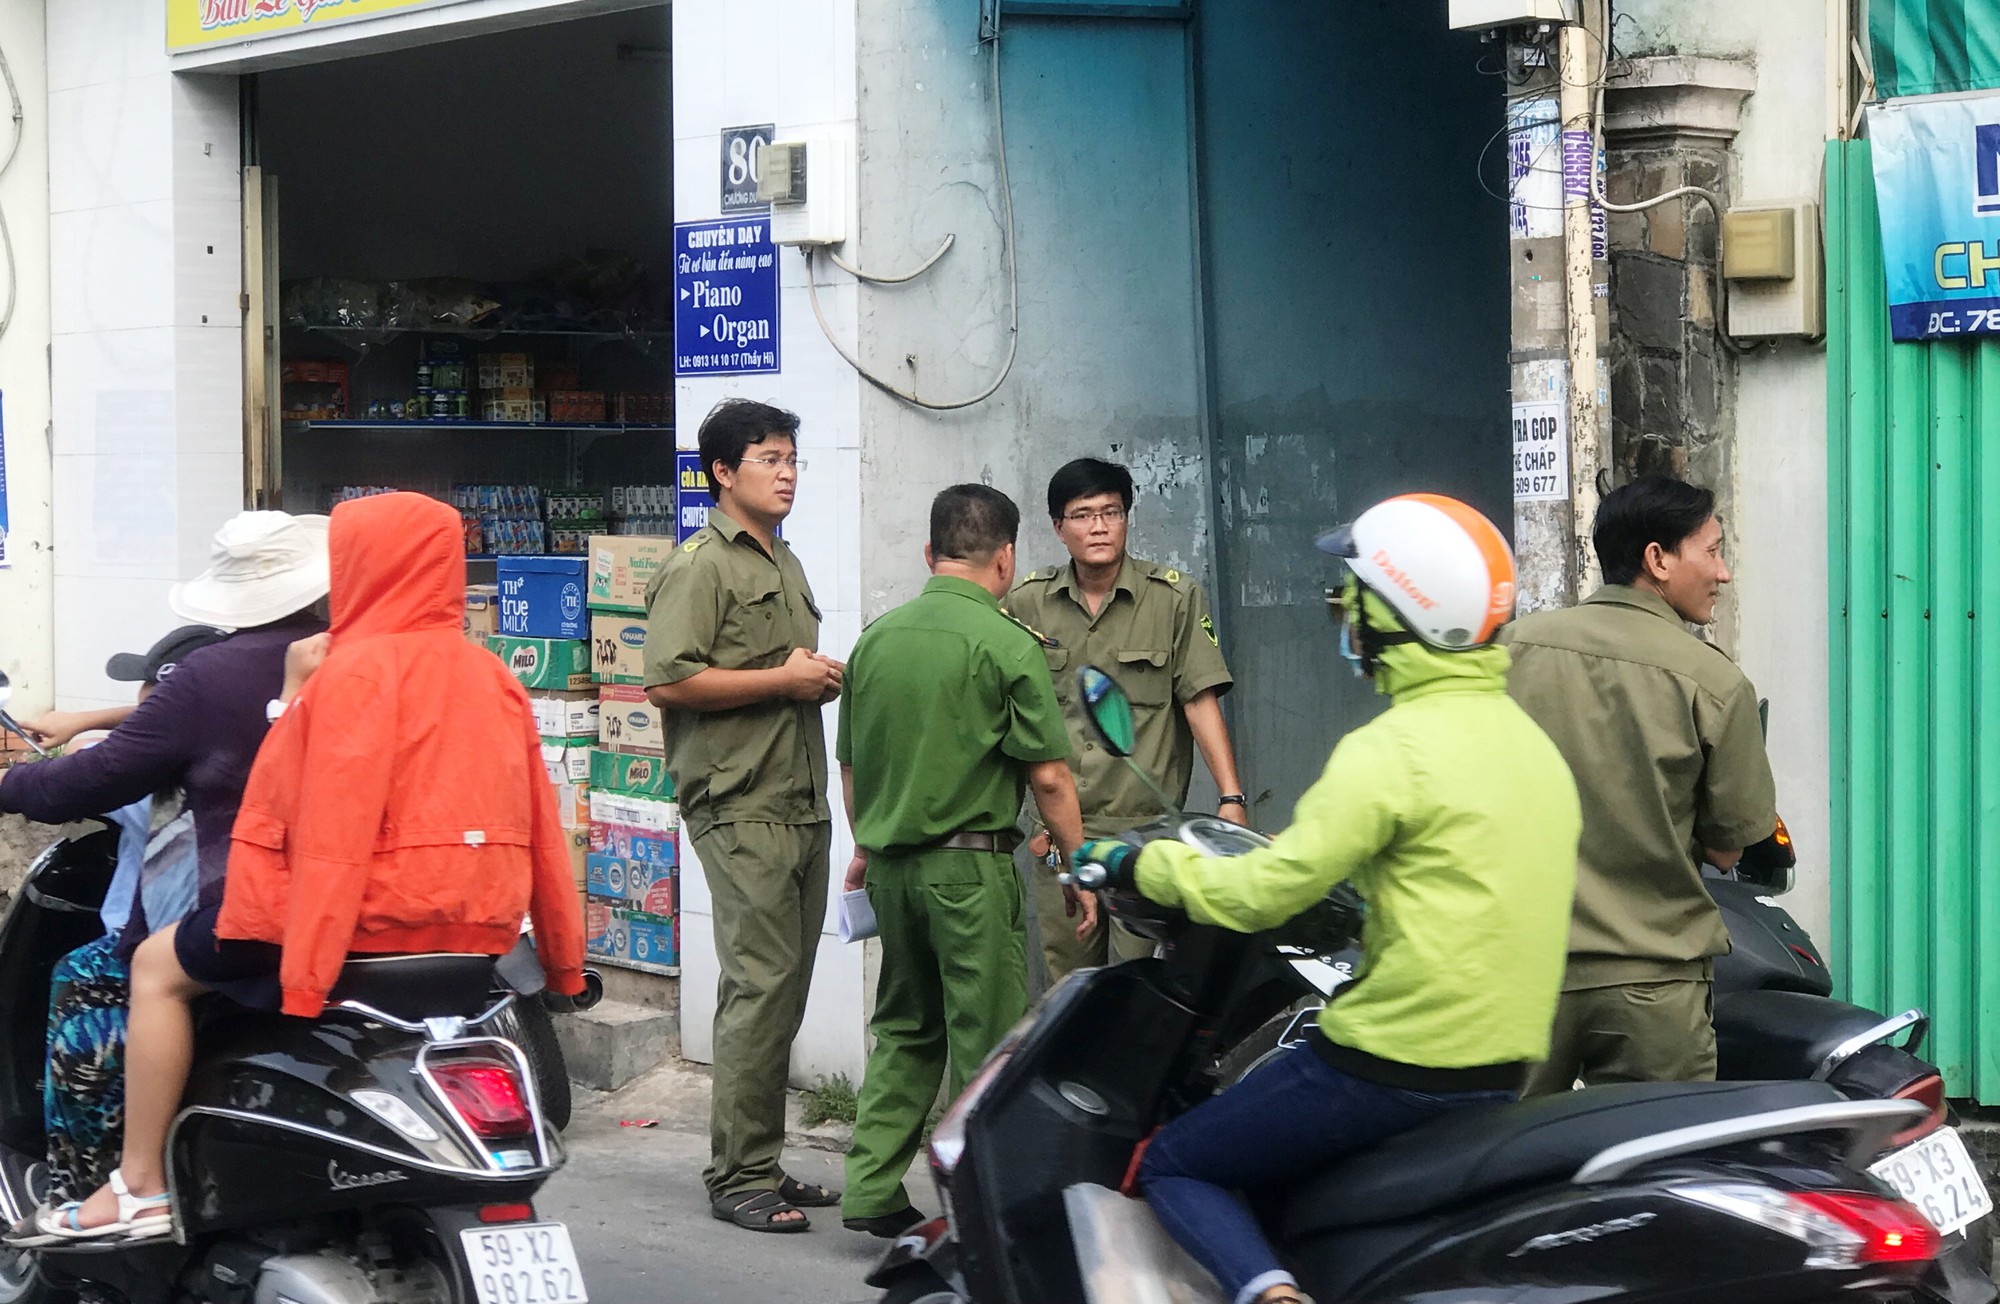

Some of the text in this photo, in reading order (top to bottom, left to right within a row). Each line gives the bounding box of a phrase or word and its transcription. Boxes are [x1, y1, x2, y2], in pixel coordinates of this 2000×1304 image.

[688, 225, 762, 248] CHUYÊN DẠY
[678, 253, 691, 274] Từ
[702, 251, 717, 272] bản
[718, 249, 733, 270] đến
[758, 253, 772, 267] cao
[693, 280, 742, 308] Piano
[713, 313, 770, 348] Organ
[1928, 312, 1961, 333] ĐC:
[679, 355, 691, 368] LH:
[692, 355, 709, 367] 0913
[711, 354, 719, 367] 14
[721, 354, 729, 366] 10
[731, 353, 739, 366] 17
[1532, 411, 1557, 441] GÓP
[1525, 444, 1556, 471] CHẤP
[681, 465, 696, 487] CỬA
[1533, 475, 1557, 492] 677
[682, 502, 709, 527] CHUYÊN
[502, 580, 517, 595] TH
[502, 595, 528, 616] true
[565, 596, 576, 607] TH
[503, 615, 528, 632] MILK
[621, 632, 645, 641] VINAMIL
[513, 654, 535, 668] MILO
[629, 767, 649, 780] MILO
[1922, 1176, 1982, 1228] 6.24
[480, 1231, 558, 1268] 59-X2
[483, 1267, 578, 1304] 982.62
